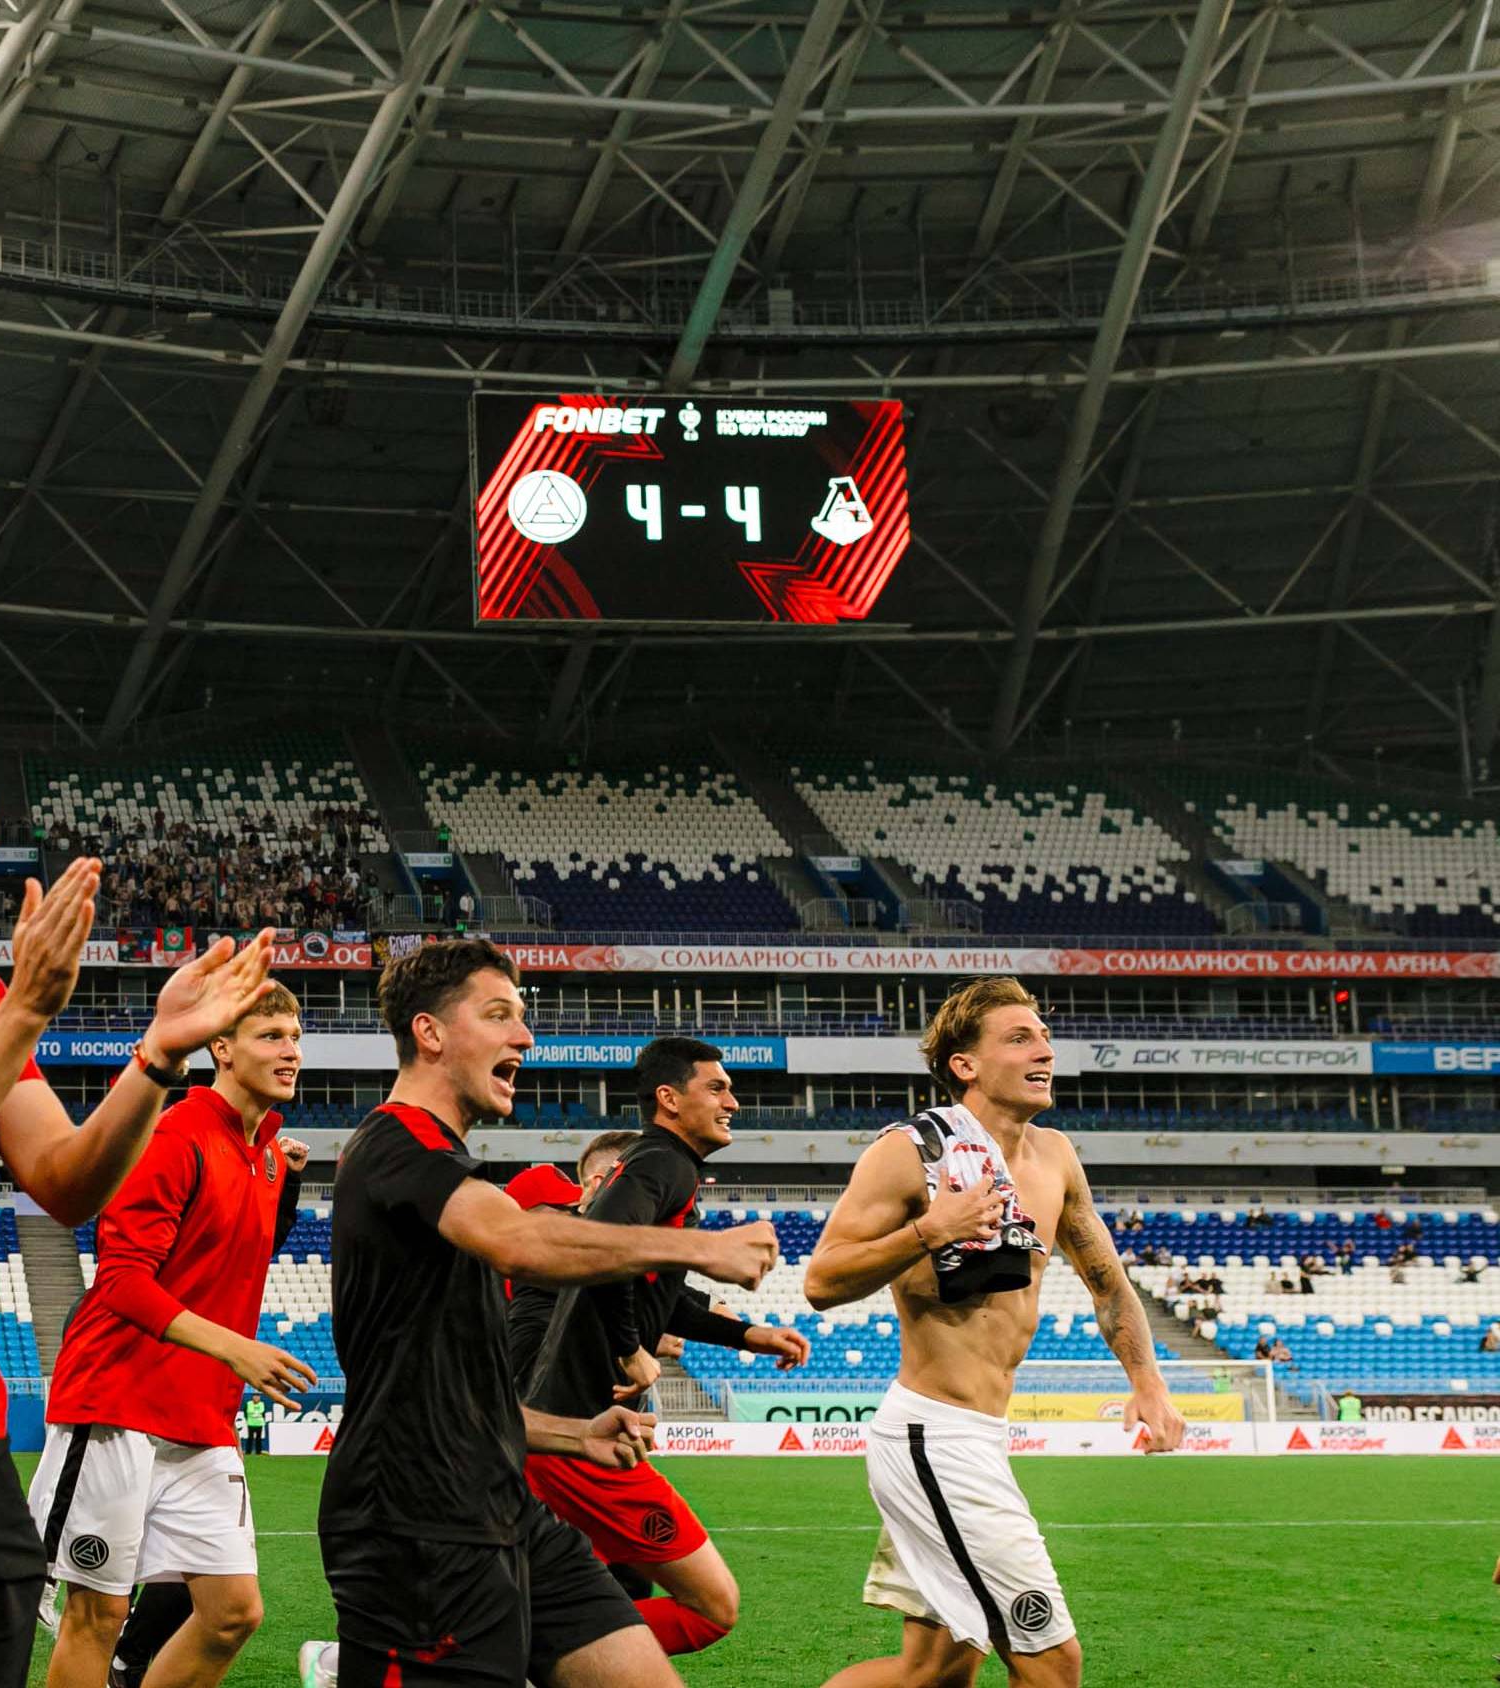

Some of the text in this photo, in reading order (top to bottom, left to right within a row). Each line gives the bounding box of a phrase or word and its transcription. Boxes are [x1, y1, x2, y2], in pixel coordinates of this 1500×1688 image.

[533, 406, 666, 434] FONBET
[766, 410, 828, 425] РОССИИ
[626, 484, 662, 541] 4
[724, 486, 762, 542] 4
[661, 950, 1013, 969] СОЛИДАРНОСТЬ САМАРА АРЕНА
[1104, 953, 1451, 973] СОЛИДАРНОСТЬ САМАРА АРЕНА
[527, 1046, 774, 1064] ПРАВИТЕЛЬСТВО БЛАСТИ
[1133, 1049, 1180, 1065] ДСК
[1190, 1047, 1359, 1066] ТРАНССТРОЙ
[667, 1427, 714, 1438] АКРОН
[812, 1428, 859, 1438] АКРОН
[1320, 1426, 1366, 1437] АКРОН
[667, 1439, 735, 1452] ХОЛДИНГ
[1320, 1438, 1388, 1450] ХОЛДИНГ
